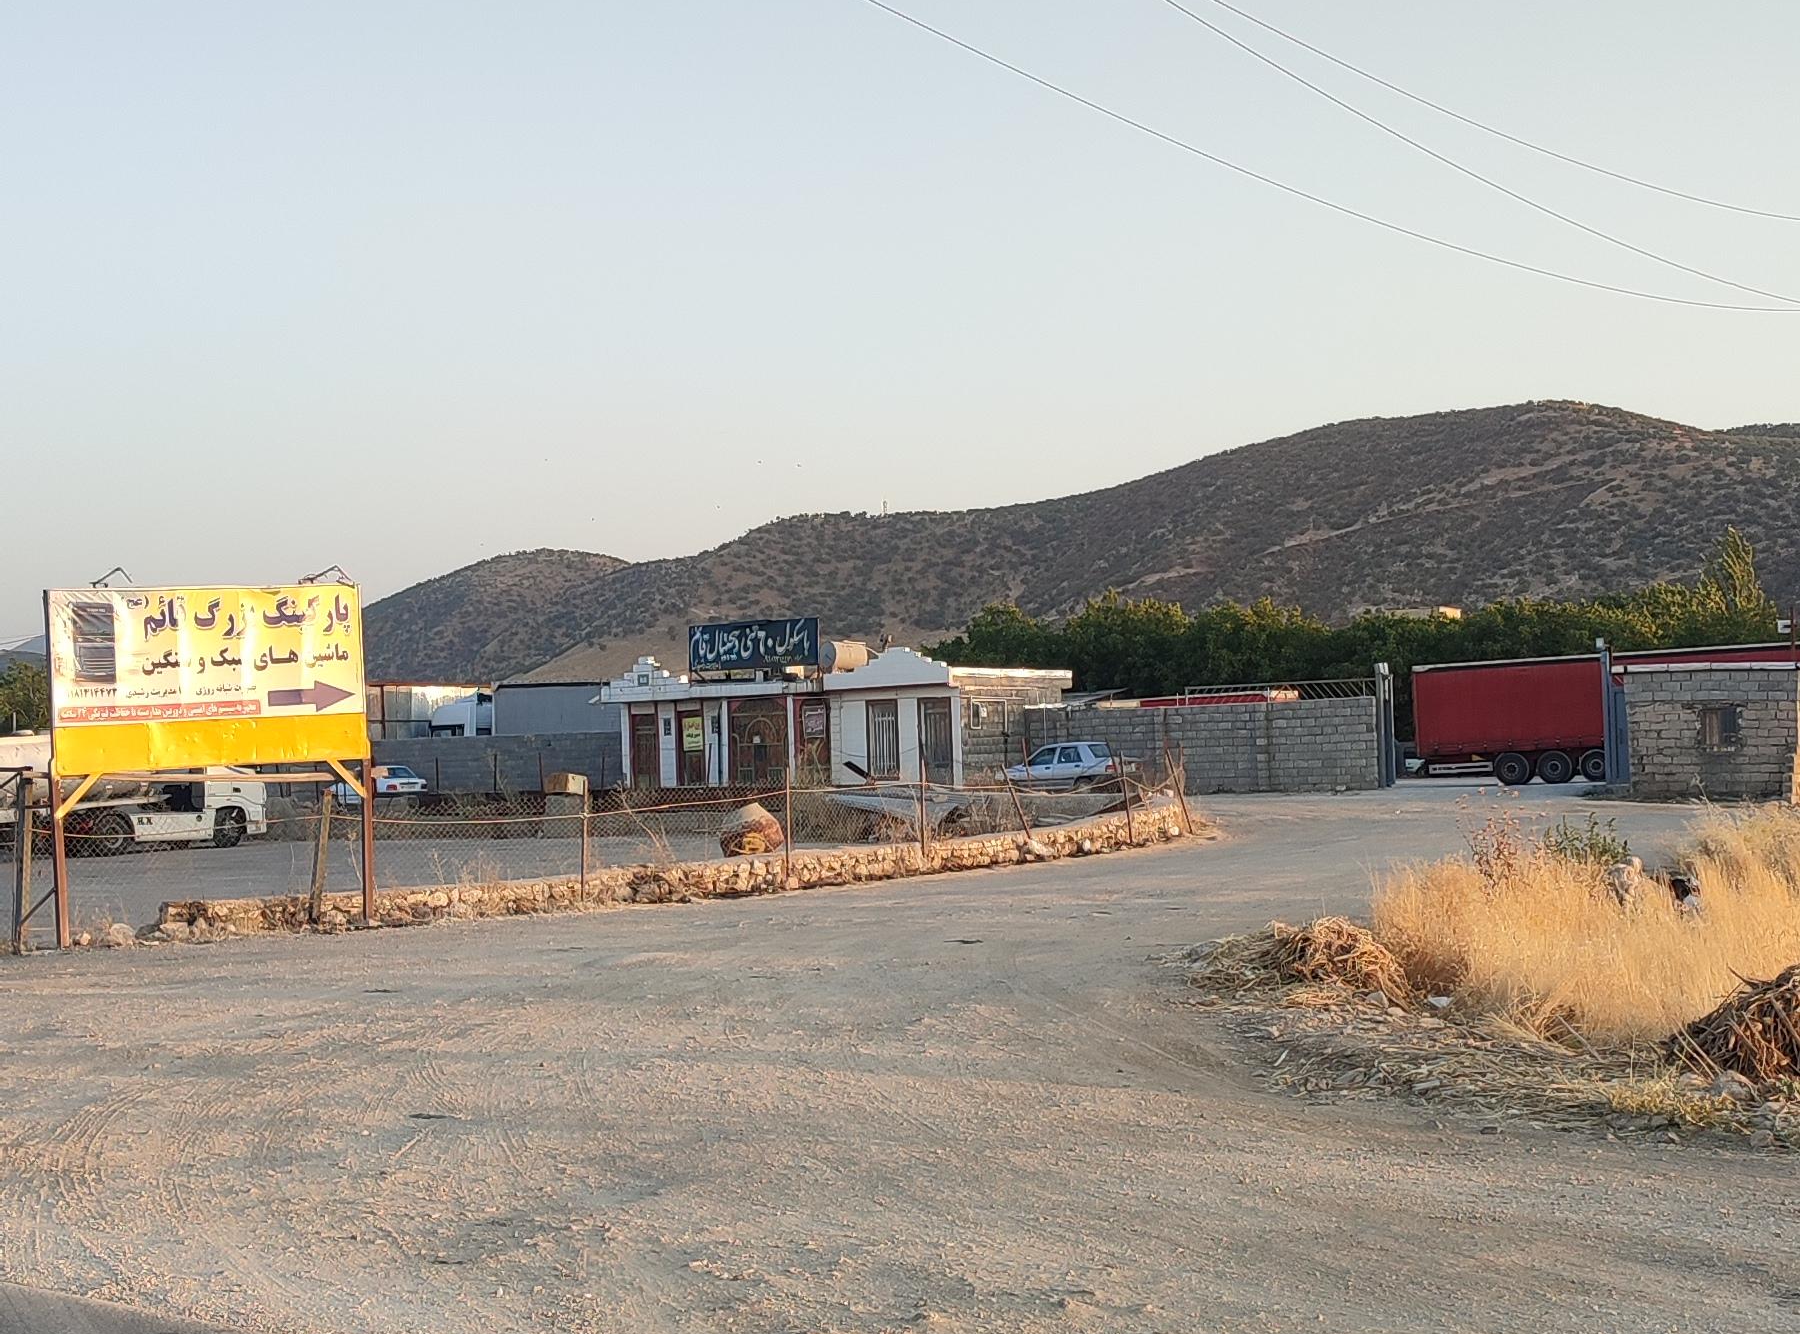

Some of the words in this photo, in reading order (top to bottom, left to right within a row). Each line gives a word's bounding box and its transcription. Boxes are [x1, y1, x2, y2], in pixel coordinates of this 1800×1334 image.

[194, 596, 255, 639] زرگ
[142, 649, 191, 676] نگین
[197, 655, 206, 674] و
[254, 645, 300, 671] های
